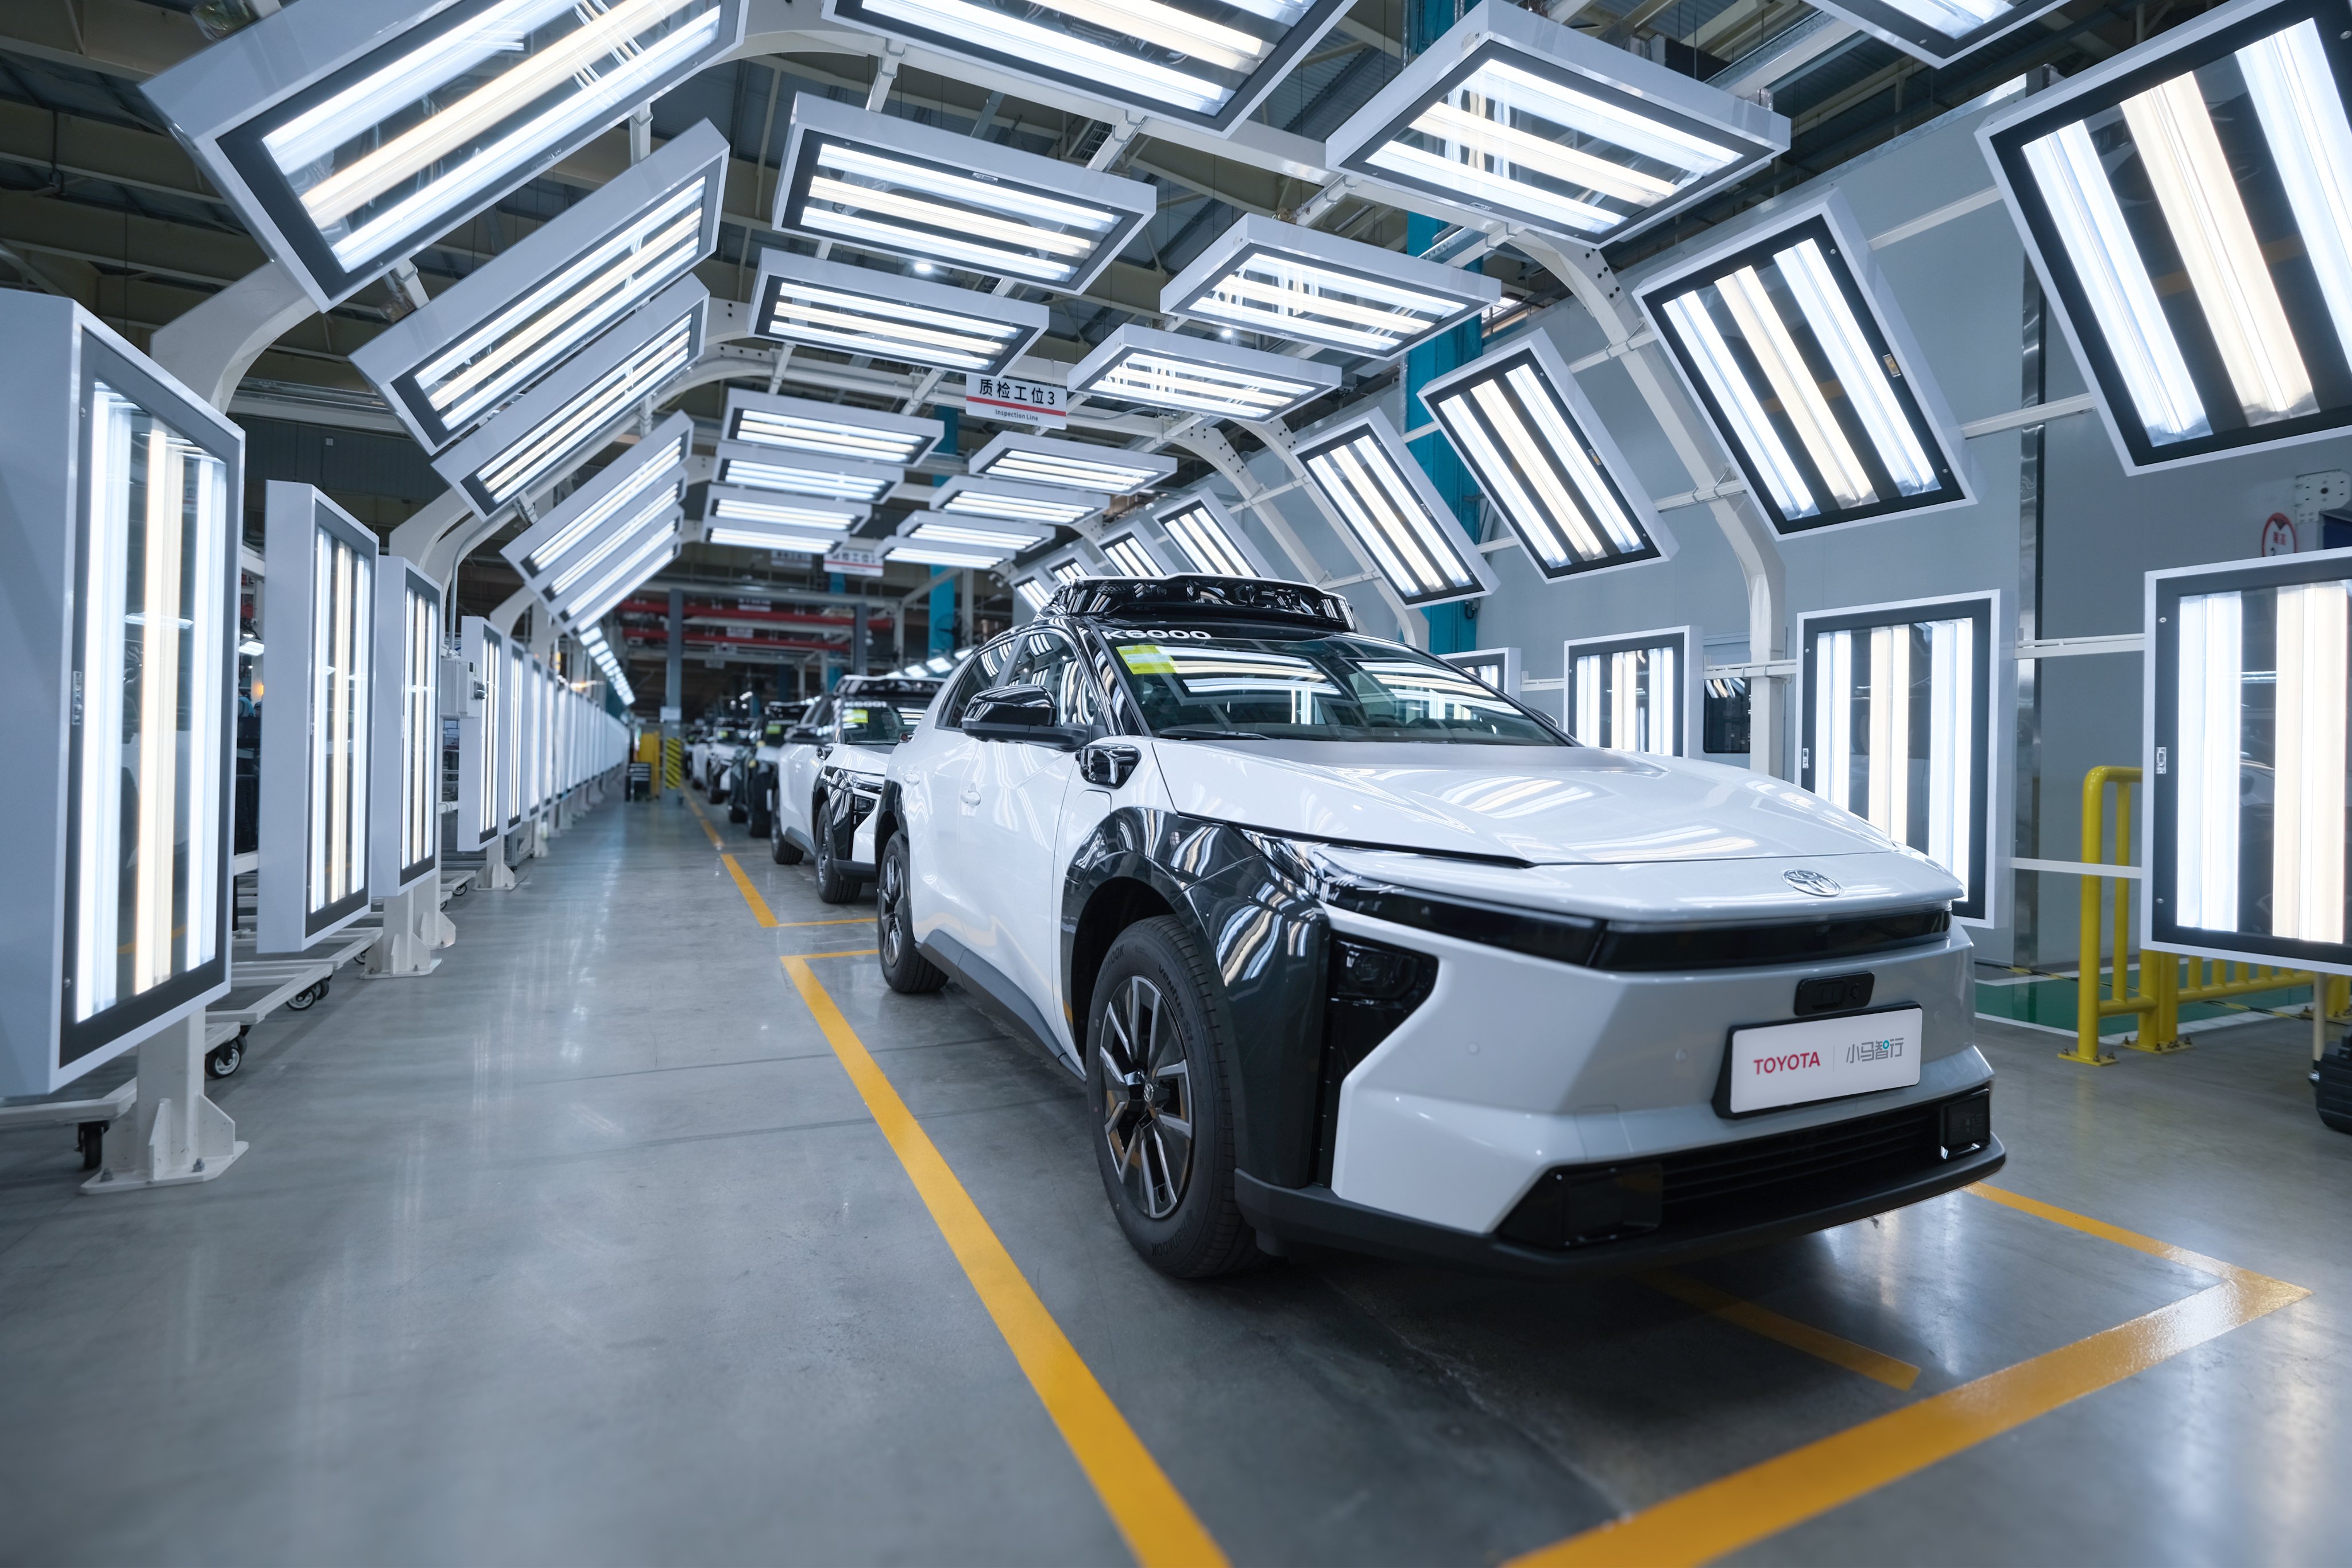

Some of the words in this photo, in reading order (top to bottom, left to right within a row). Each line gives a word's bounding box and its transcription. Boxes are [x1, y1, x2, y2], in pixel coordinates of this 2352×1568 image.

[980, 378, 1055, 405] 质检工位3
[995, 409, 1026, 419] Inspection
[1026, 413, 1039, 421] Line
[1101, 630, 1212, 640] K6000
[1846, 1037, 1905, 1063] 小马智行
[1753, 1051, 1820, 1075] TOYOTA
